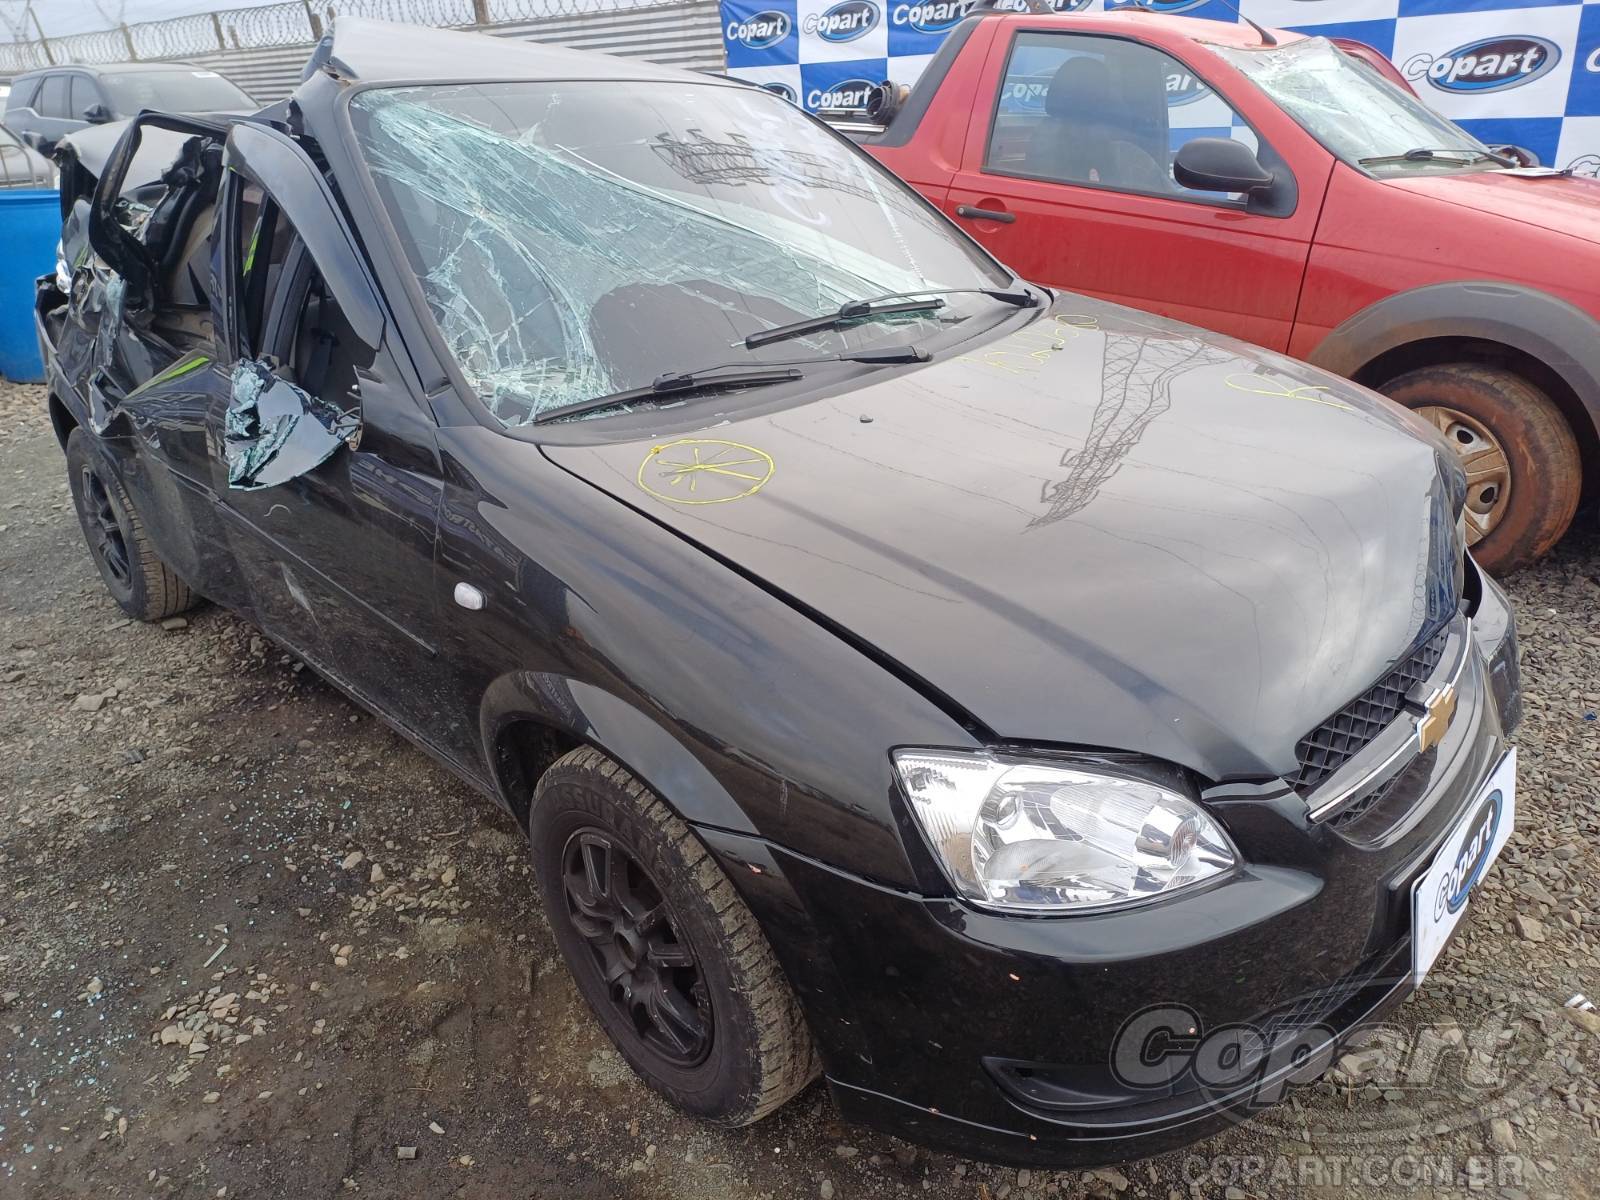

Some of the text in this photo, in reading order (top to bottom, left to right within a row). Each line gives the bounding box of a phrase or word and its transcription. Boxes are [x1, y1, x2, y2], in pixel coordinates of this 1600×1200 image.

[803, 7, 871, 35] Copart
[893, 0, 974, 26] Copart
[726, 16, 784, 42] Copart
[1402, 38, 1543, 85] Copart
[807, 86, 872, 108] Copart
[1434, 804, 1495, 923] Copart
